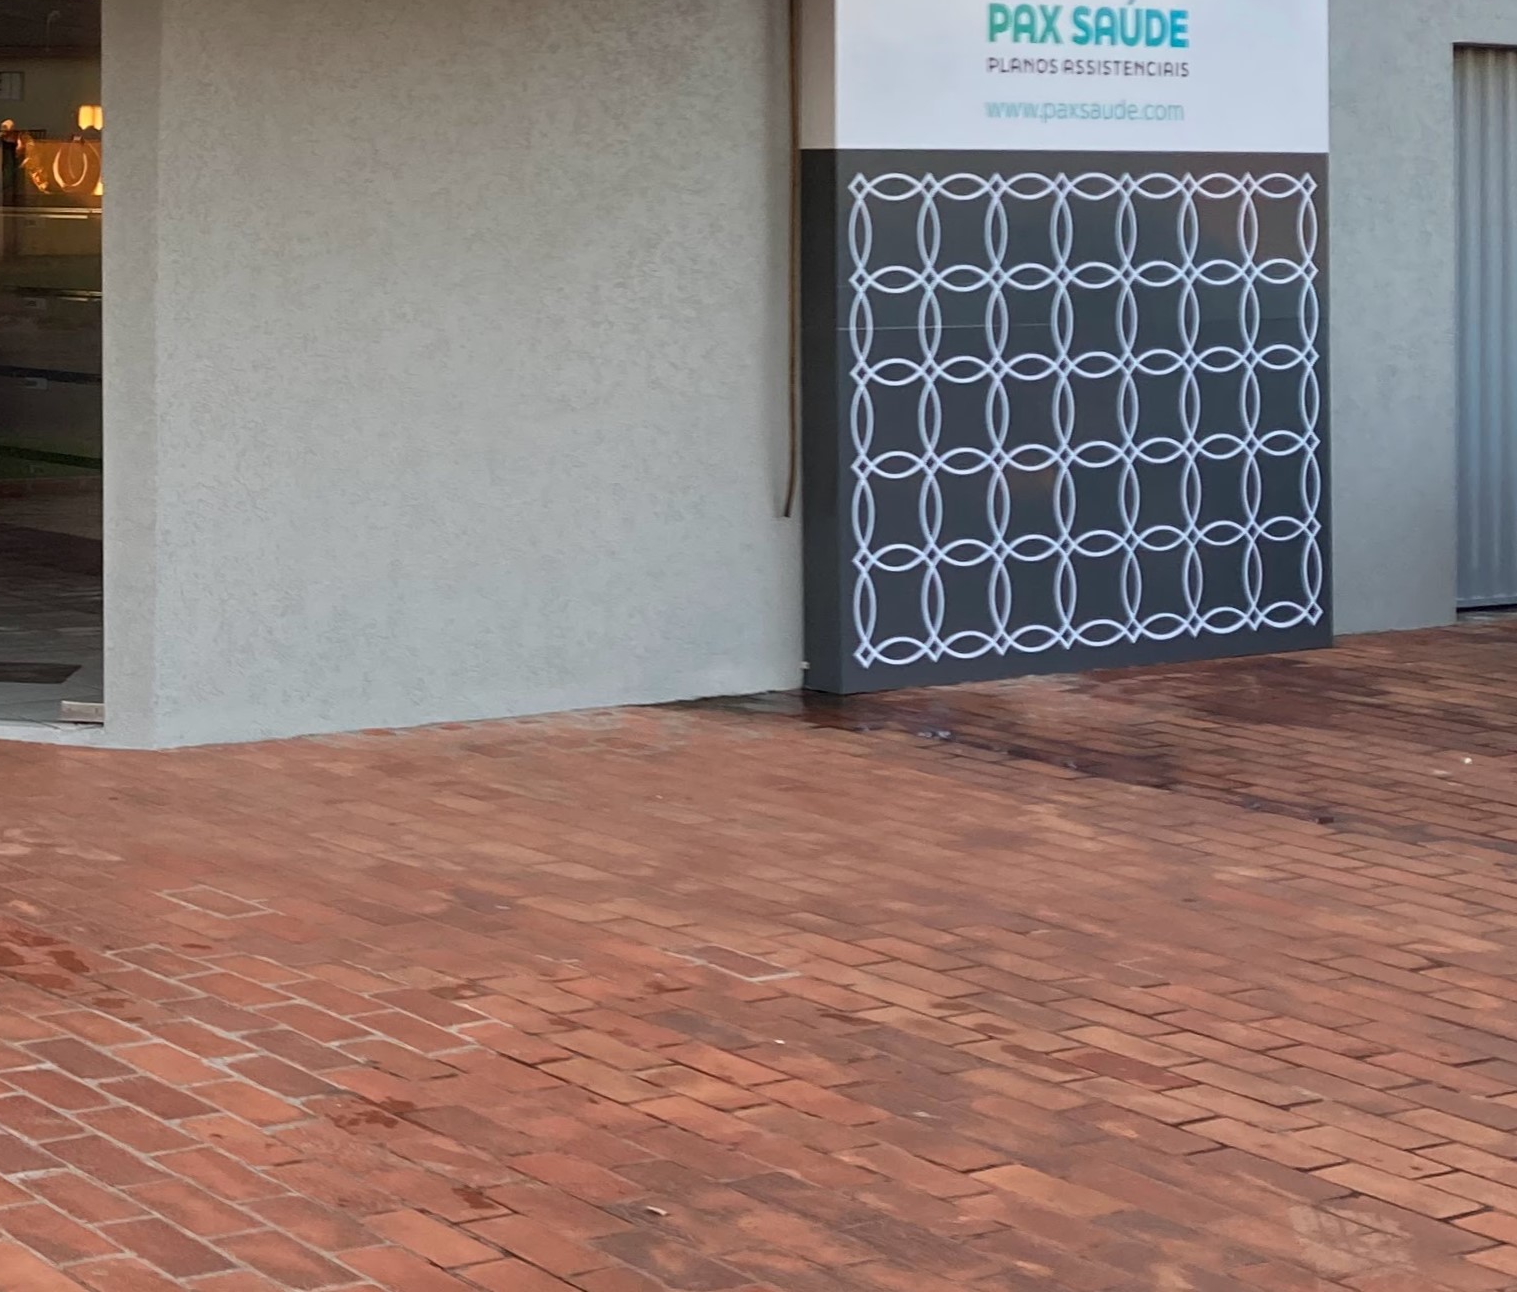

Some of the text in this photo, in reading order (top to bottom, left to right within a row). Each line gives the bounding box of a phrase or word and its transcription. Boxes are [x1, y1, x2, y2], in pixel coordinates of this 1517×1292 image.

[987, 3, 1064, 44] PAX
[986, 57, 1190, 78] PLANOS ASSISTENCIAIS
[985, 100, 1184, 123] www.paxsaude.com
